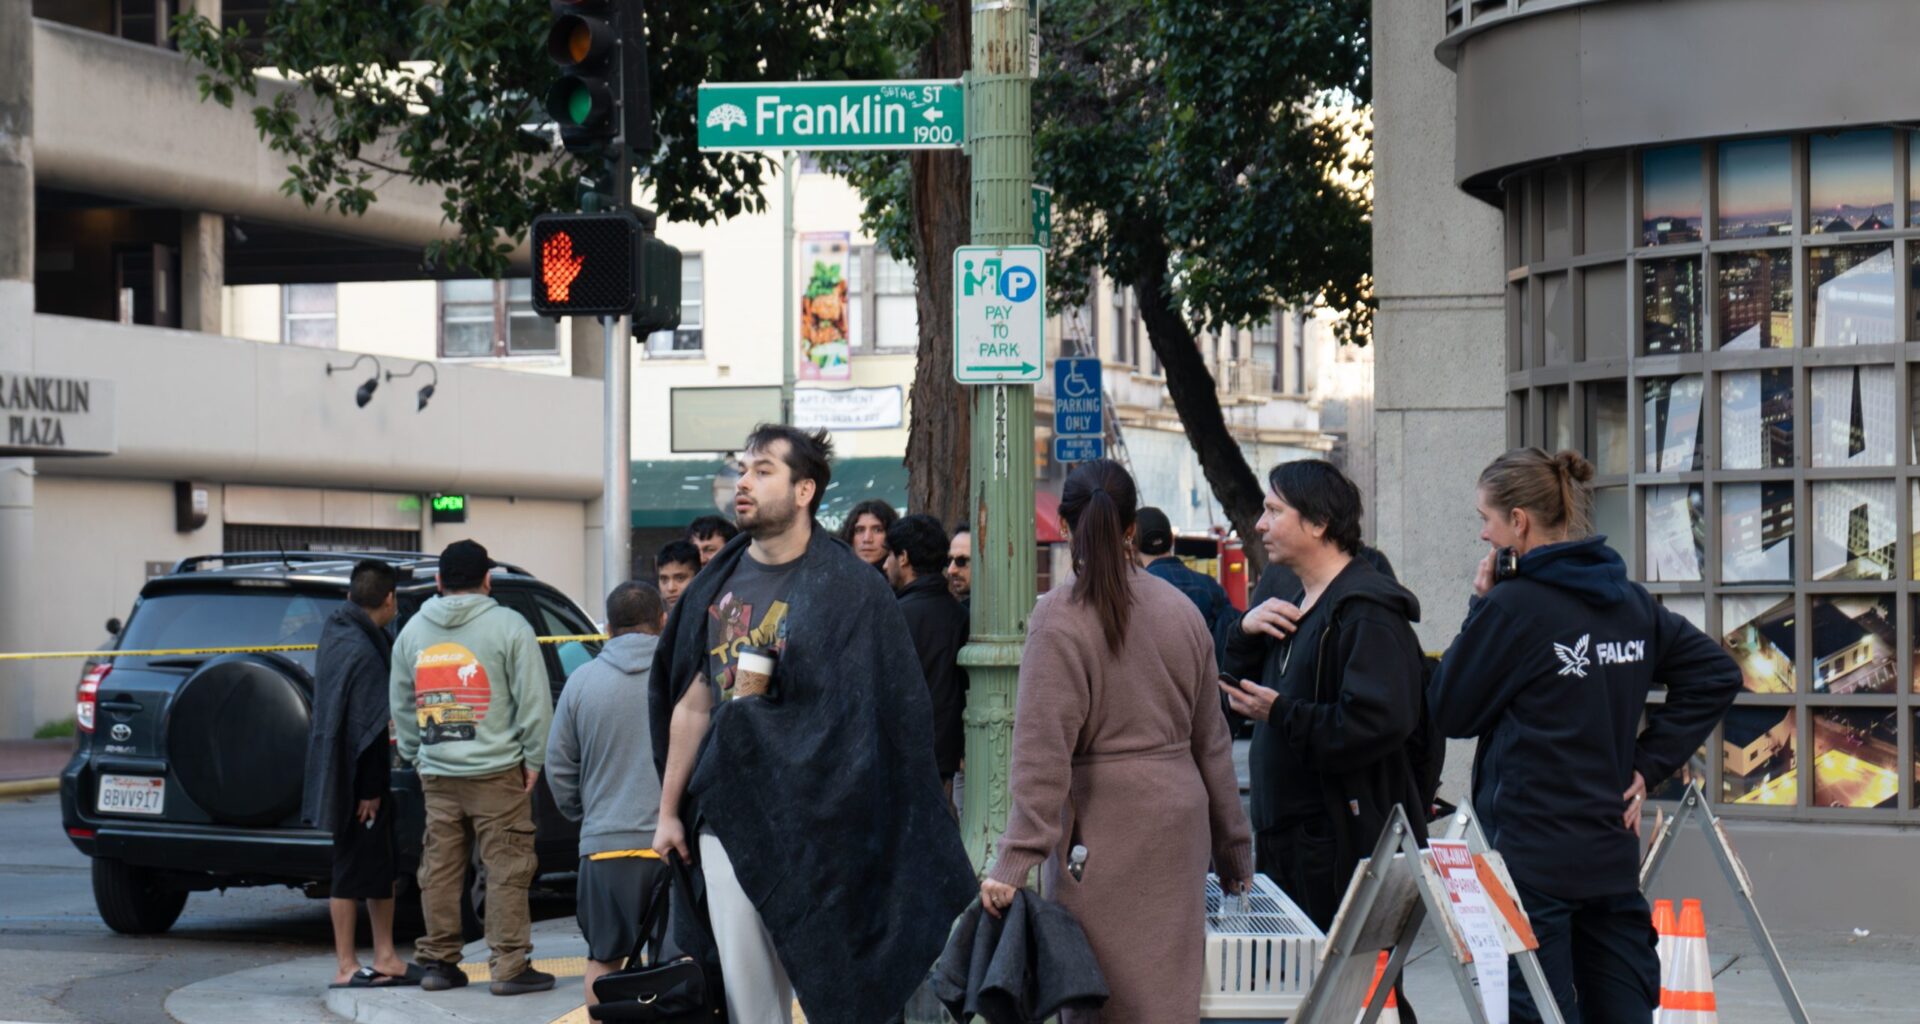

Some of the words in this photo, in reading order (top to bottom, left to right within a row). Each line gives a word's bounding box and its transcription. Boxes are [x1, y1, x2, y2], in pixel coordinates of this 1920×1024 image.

[756, 94, 905, 136] Franklin
[922, 86, 943, 103] ST
[913, 125, 953, 143] 1900
[985, 305, 1013, 320] PAY
[991, 324, 1009, 339] TO
[980, 343, 1019, 357] PARK
[1057, 398, 1100, 413] PARKING
[8, 416, 65, 446] PLAZA
[1065, 415, 1091, 431] ONLY
[1596, 640, 1645, 665] FALCK
[103, 788, 160, 809] 8BVV917
